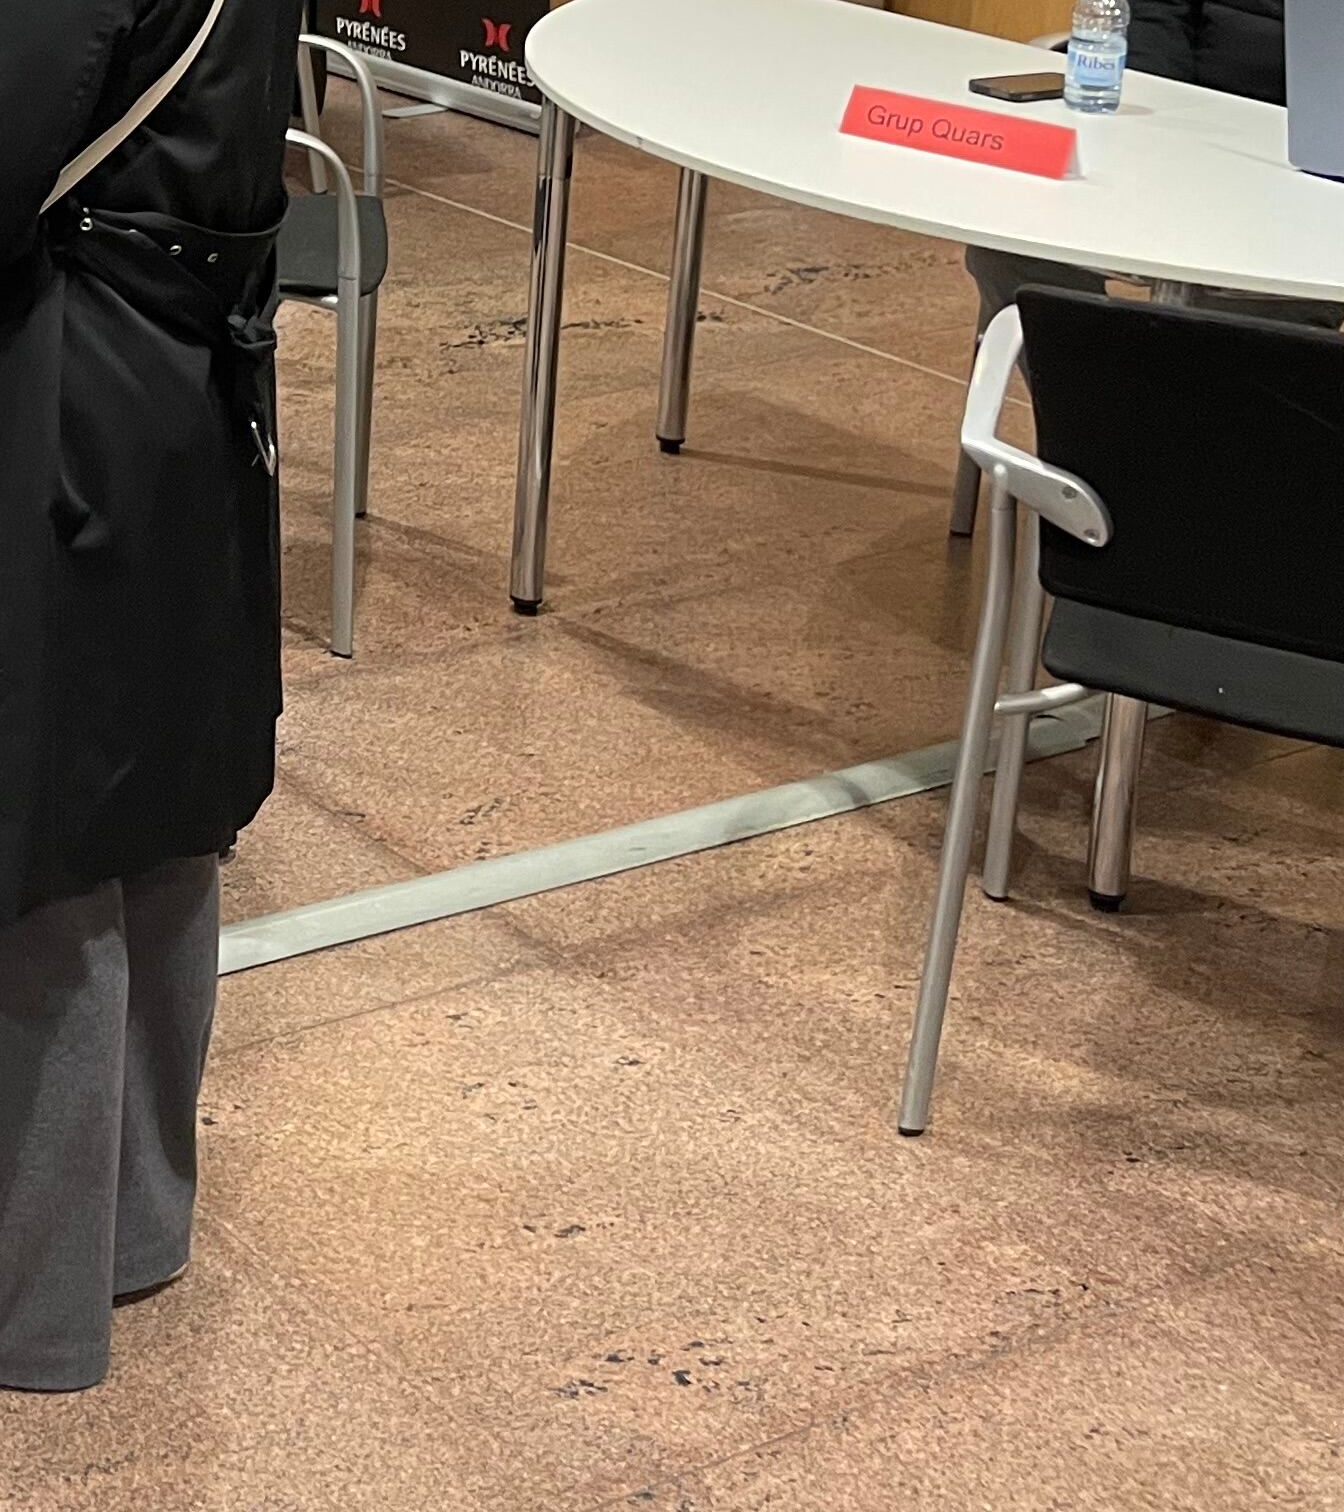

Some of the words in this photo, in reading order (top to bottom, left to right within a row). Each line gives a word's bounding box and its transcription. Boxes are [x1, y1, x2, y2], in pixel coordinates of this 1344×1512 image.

[335, 17, 406, 52] PYRÉNÉES
[867, 104, 924, 137] Grup
[931, 118, 1005, 151] Quars
